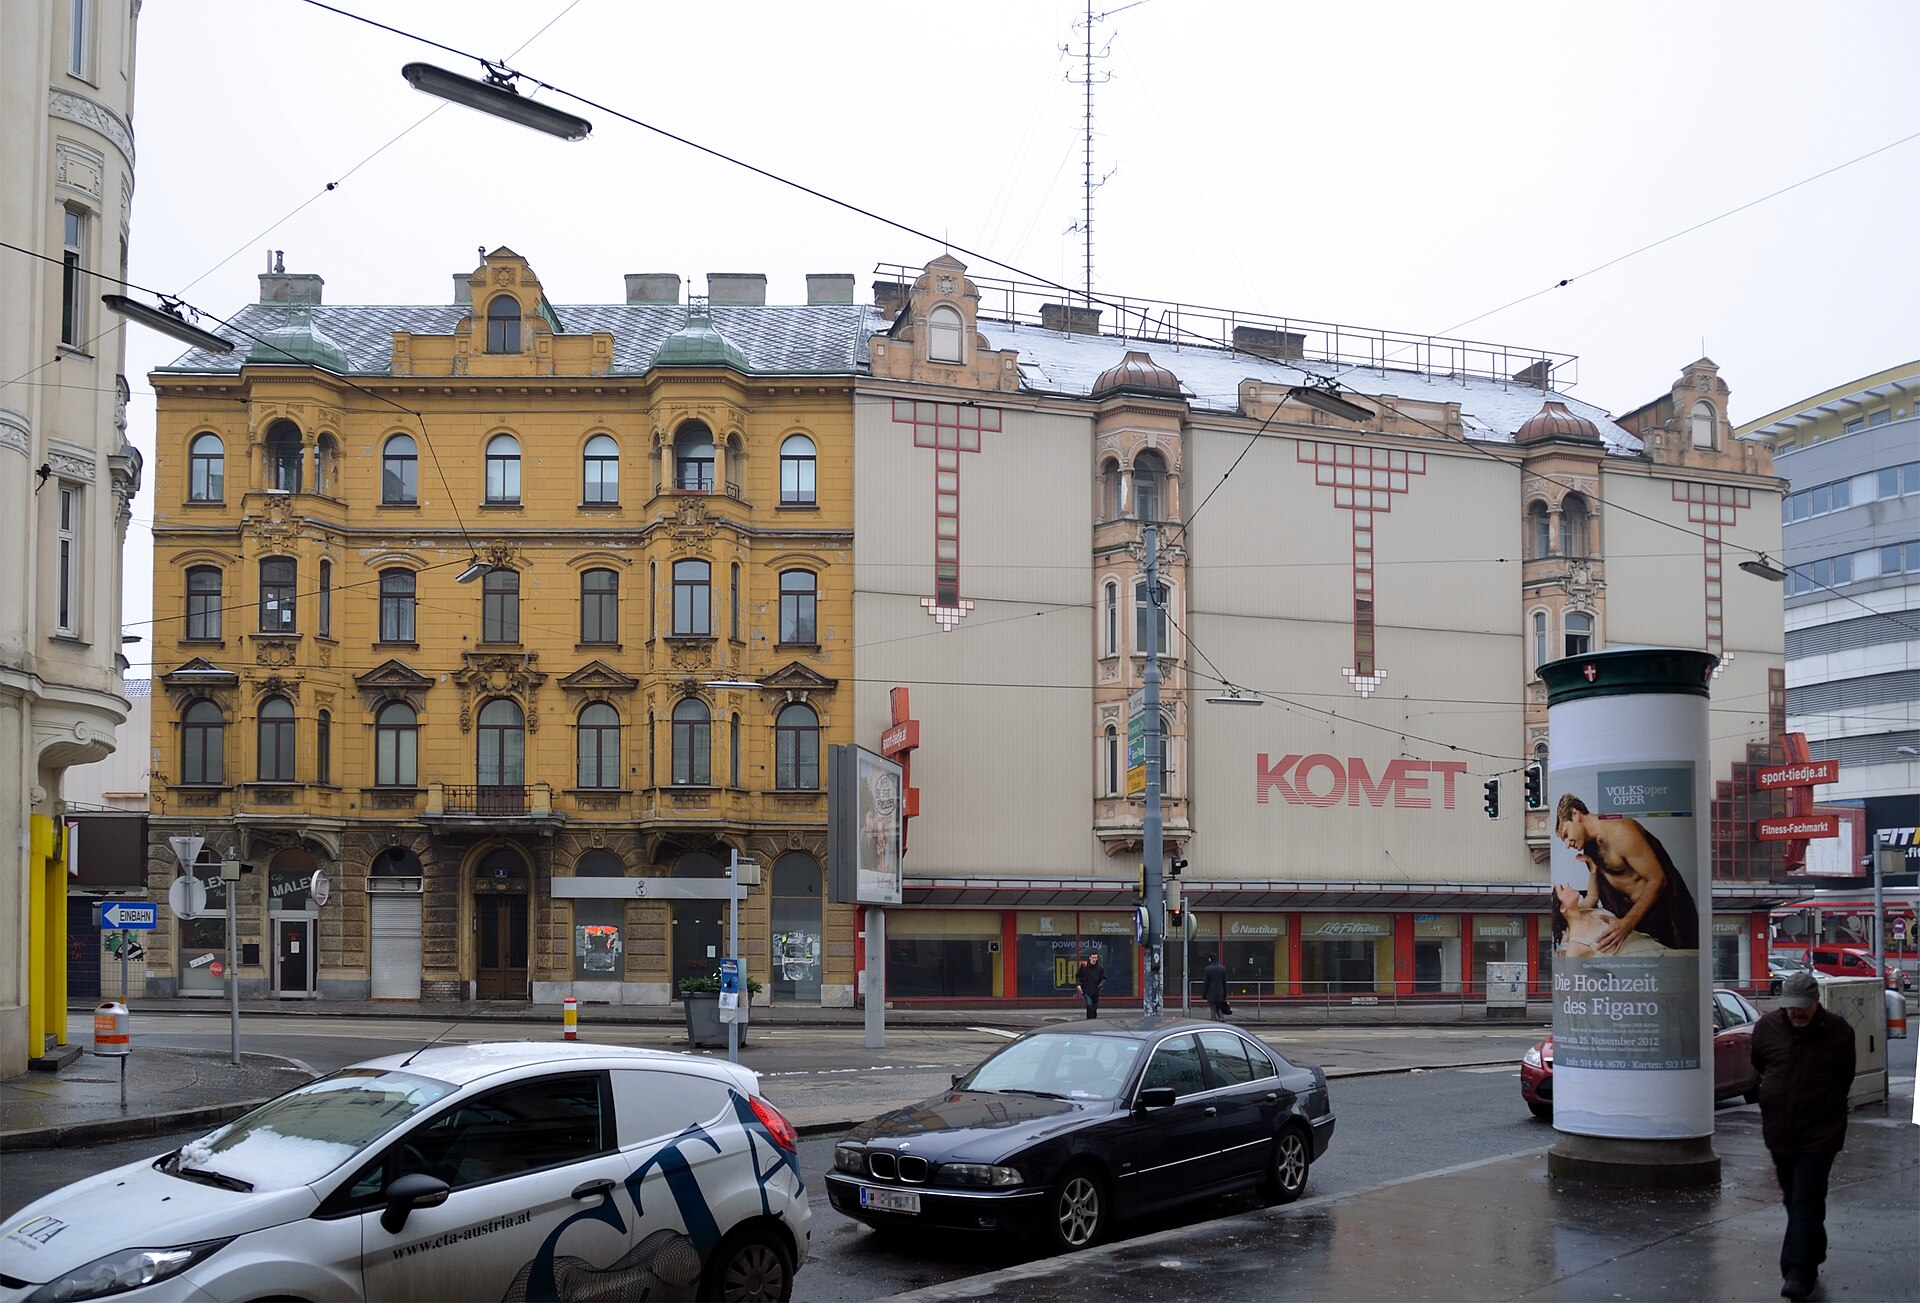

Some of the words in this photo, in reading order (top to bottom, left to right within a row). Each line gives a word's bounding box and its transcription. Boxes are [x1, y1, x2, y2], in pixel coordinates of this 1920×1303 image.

[1256, 752, 1468, 810] KOMET
[1761, 766, 1828, 786] sport-tiedje.at
[1613, 795, 1646, 806] OPER
[1761, 821, 1829, 835] Fitness-Fachmarkt
[120, 910, 151, 922] EINBAHN
[1240, 924, 1279, 934] Nautilus
[1052, 939, 1090, 949] poweed
[1092, 939, 1103, 949] by
[1555, 973, 1570, 991] Die
[1573, 973, 1659, 992] Hochzeit
[1563, 996, 1586, 1015] des
[1592, 997, 1659, 1020] Figaro
[1579, 1036, 1590, 1045] 25.
[1590, 1036, 1636, 1046] November
[1637, 1038, 1660, 1046] 2012
[1566, 1057, 1578, 1066] Info:
[1580, 1058, 1592, 1068] 514
[1593, 1060, 1626, 1069] 44-3670
[1632, 1061, 1664, 1069] Karten:
[1665, 1060, 1679, 1069] 513
[1680, 1060, 1684, 1069] 1
[1685, 1059, 1697, 1068] 513
[18, 1216, 71, 1245] CTA
[392, 1209, 532, 1260] www.cta-austria.at
